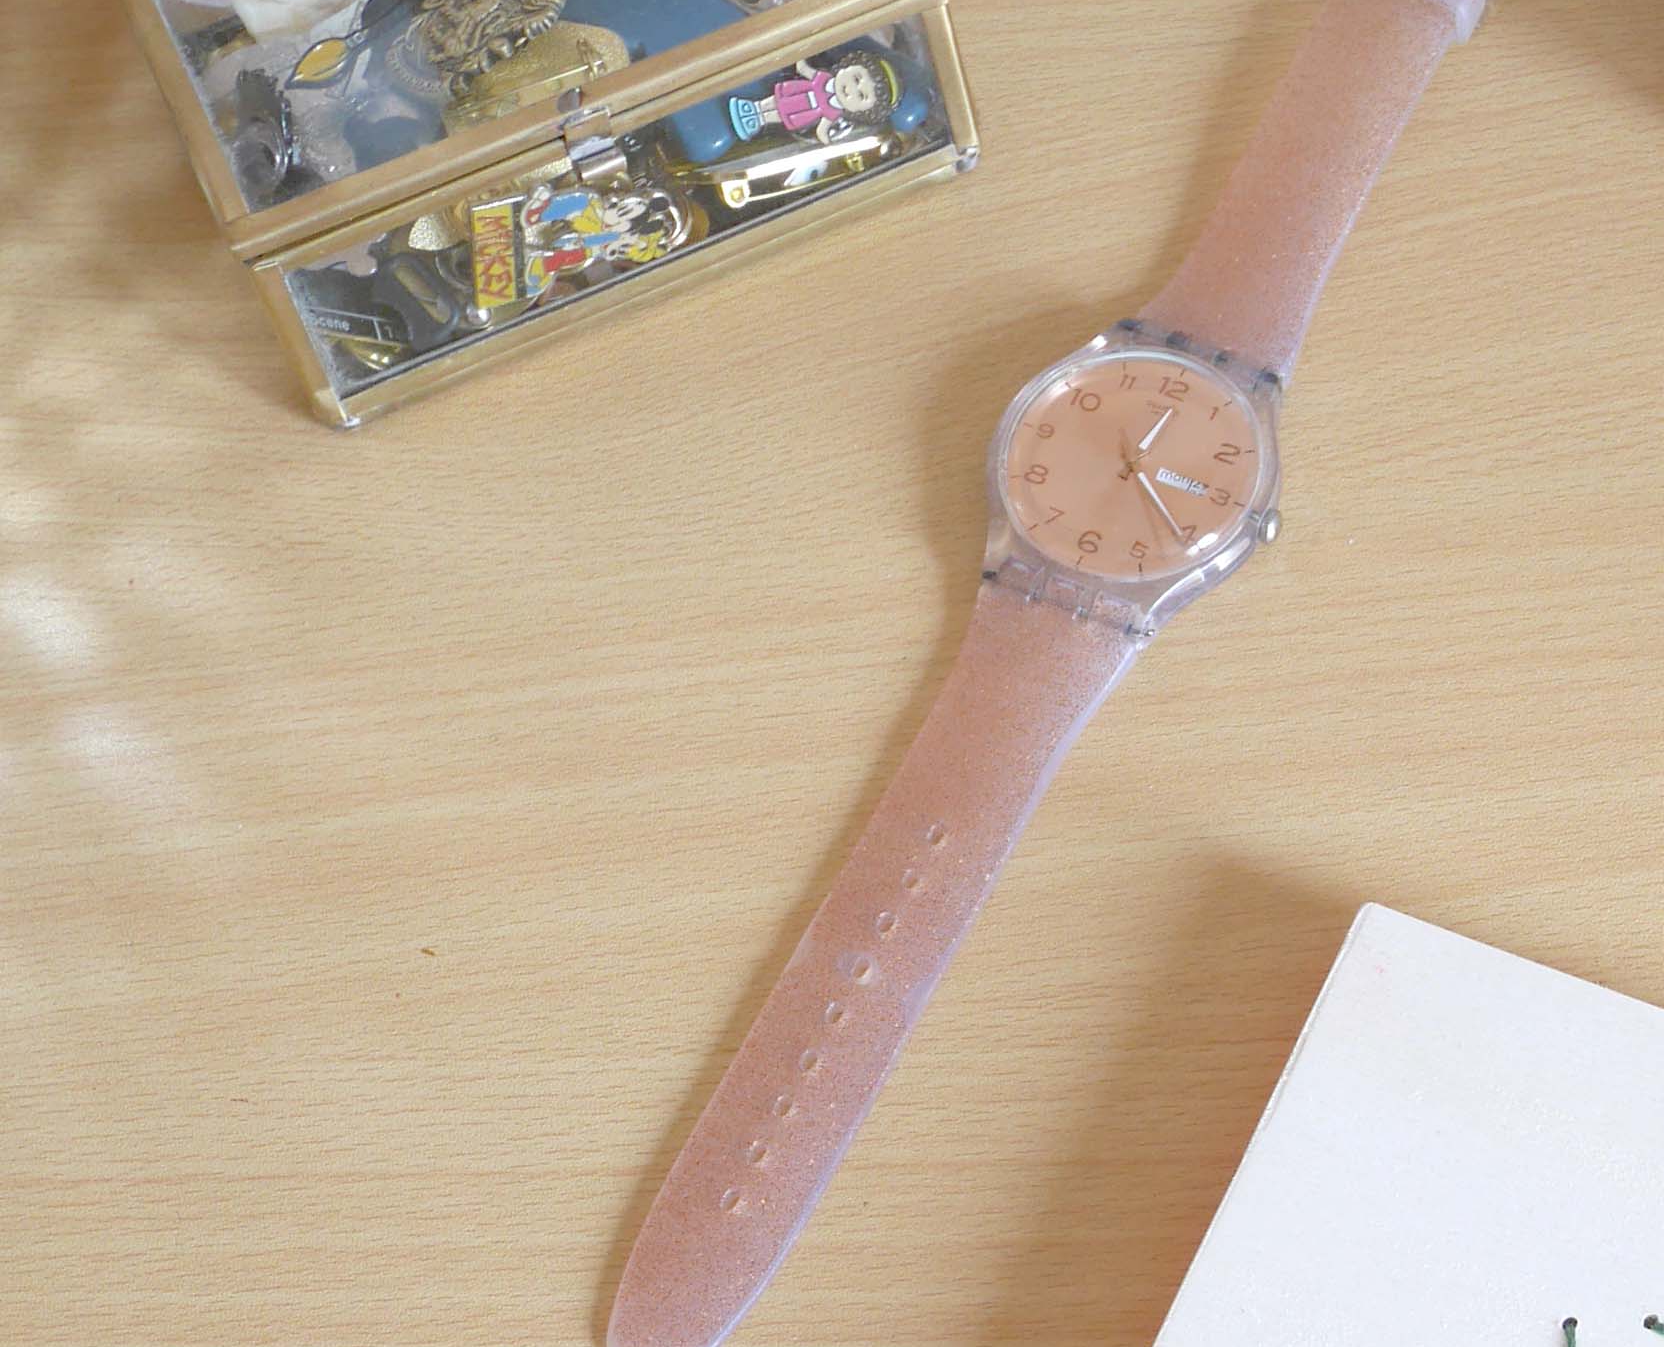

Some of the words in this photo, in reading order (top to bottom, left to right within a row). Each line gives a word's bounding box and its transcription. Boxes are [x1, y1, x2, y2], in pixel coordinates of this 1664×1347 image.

[1119, 374, 1137, 390] 11
[1158, 376, 1190, 402] 12
[1069, 388, 1102, 413] 10
[1208, 406, 1220, 421] 1
[1035, 423, 1055, 439] 9
[1213, 443, 1241, 465] 2
[1023, 463, 1049, 486] 8
[1208, 487, 1232, 507] 3
[1045, 506, 1065, 526] 7
[1077, 530, 1102, 555] 6
[1129, 540, 1149, 560] 5
